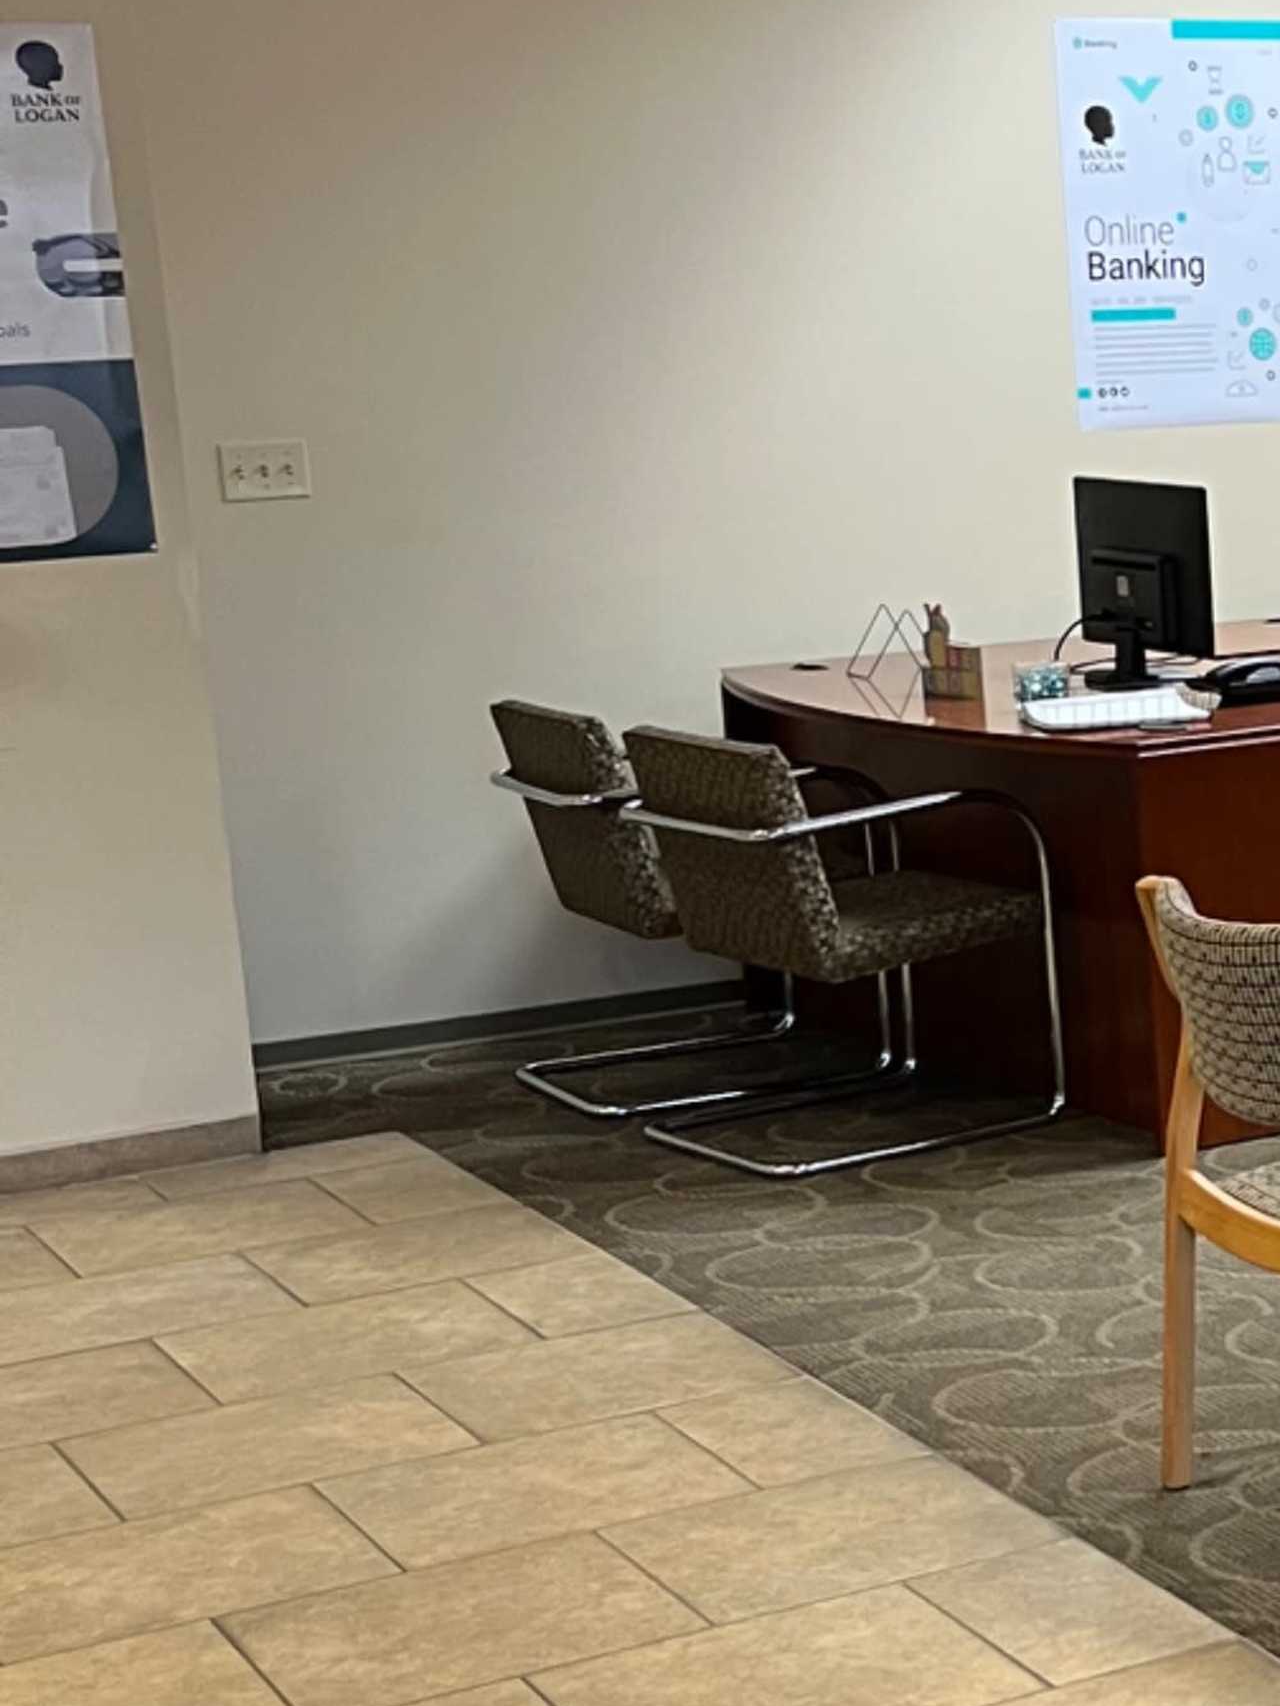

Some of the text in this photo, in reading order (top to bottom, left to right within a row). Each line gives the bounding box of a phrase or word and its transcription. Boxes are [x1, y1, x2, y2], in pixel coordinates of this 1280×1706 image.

[10, 93, 62, 107] BANK
[15, 108, 79, 122] LOGAN
[1079, 149, 1113, 160] BANK
[1081, 163, 1126, 174] LOGAN
[1084, 213, 1175, 247] Online
[1088, 249, 1205, 287] Banking
